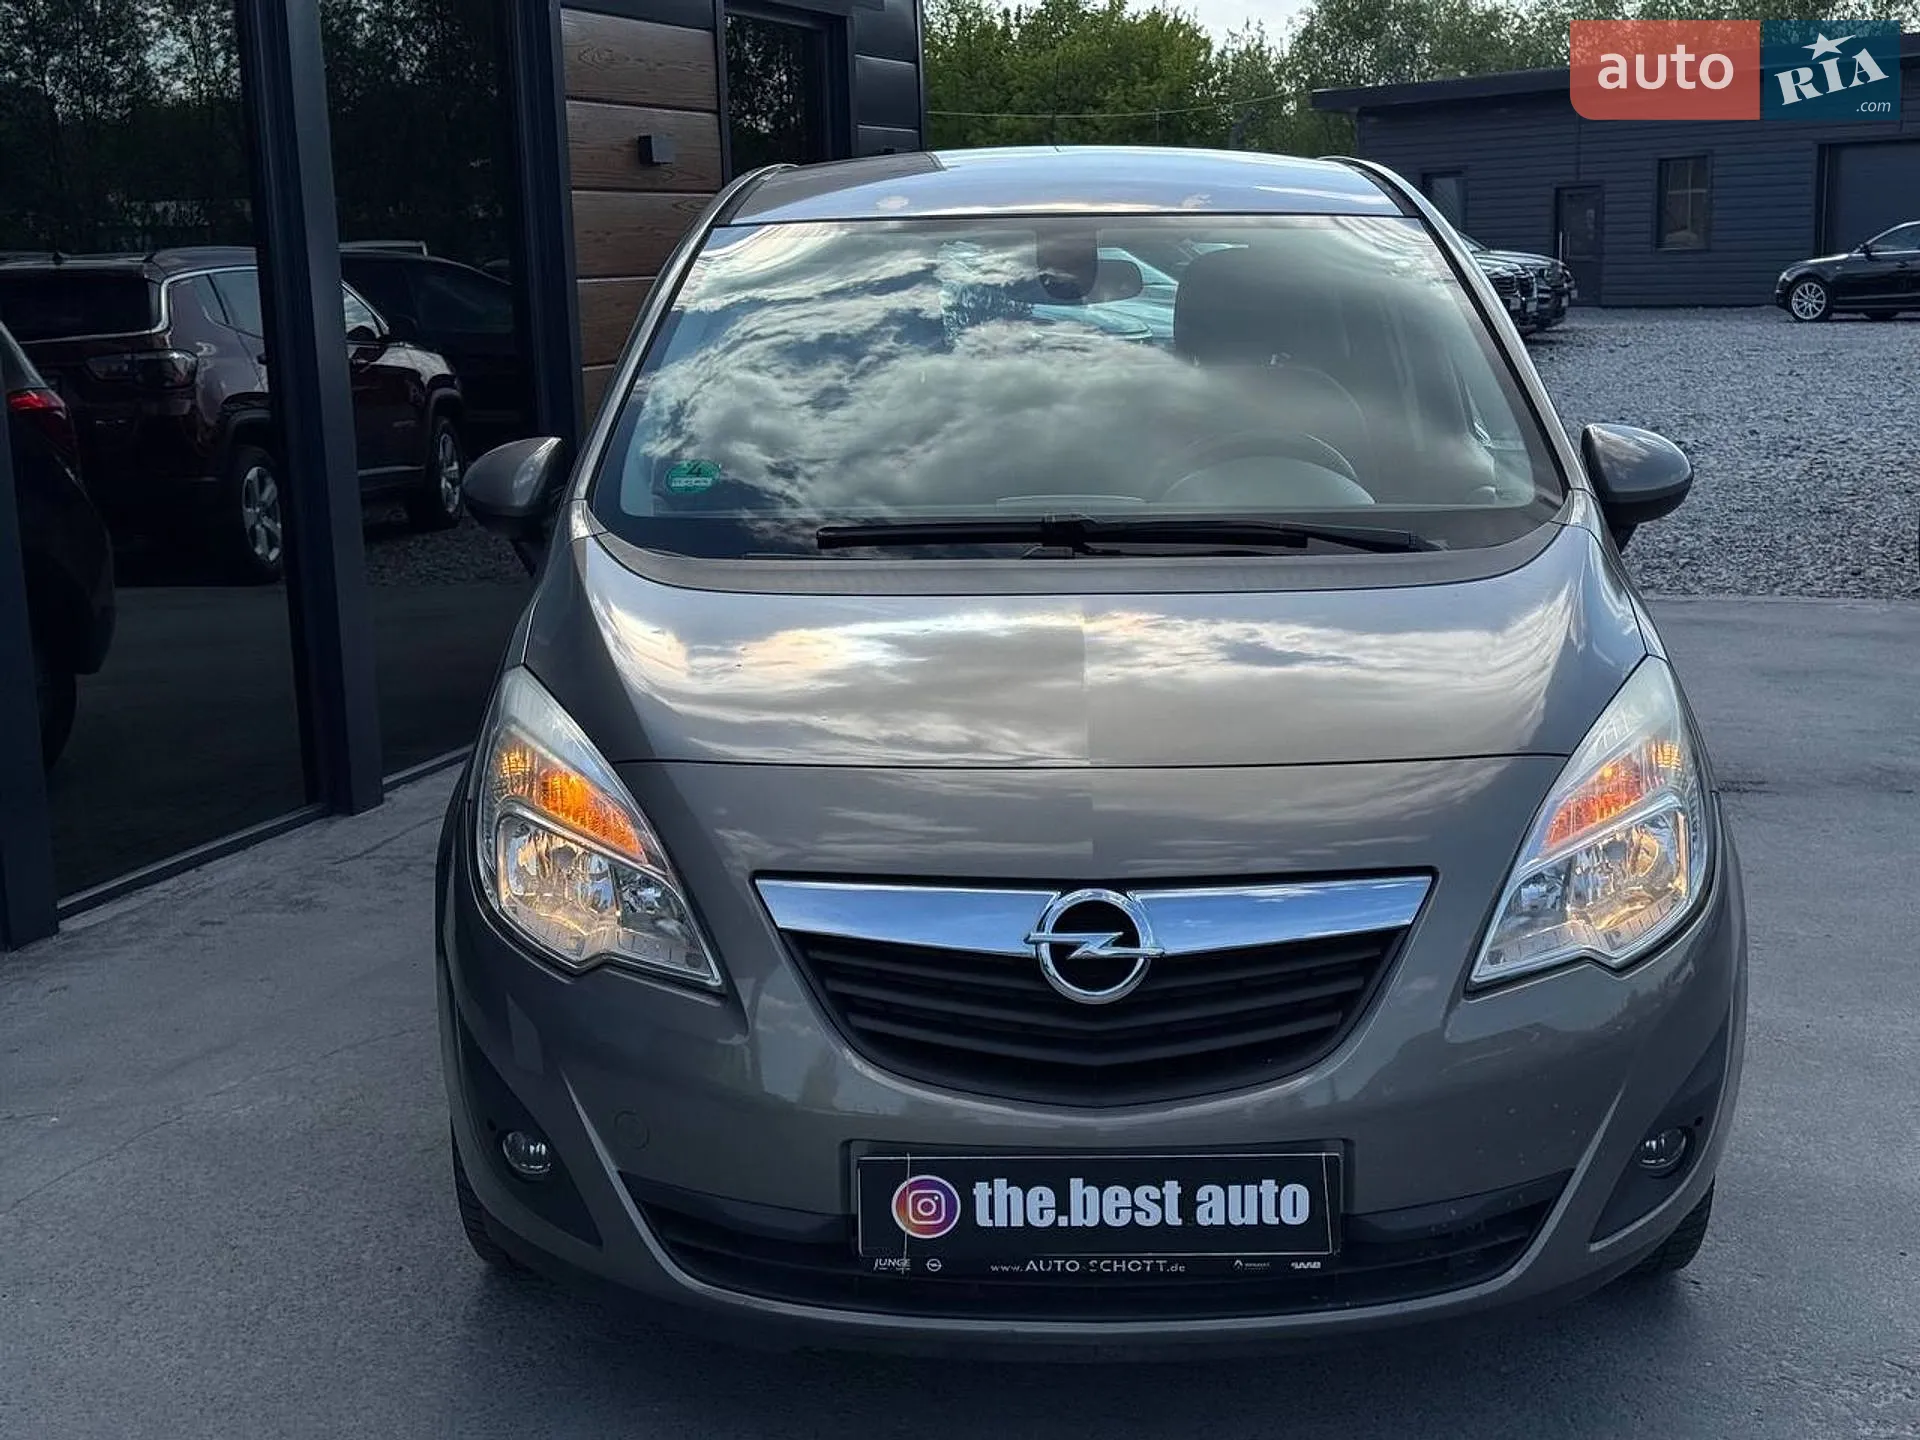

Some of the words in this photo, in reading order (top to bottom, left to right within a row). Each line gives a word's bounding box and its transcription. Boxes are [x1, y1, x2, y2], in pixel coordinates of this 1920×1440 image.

[686, 460, 702, 477] 4
[973, 1178, 1183, 1227] the.best
[1195, 1179, 1310, 1226] auto
